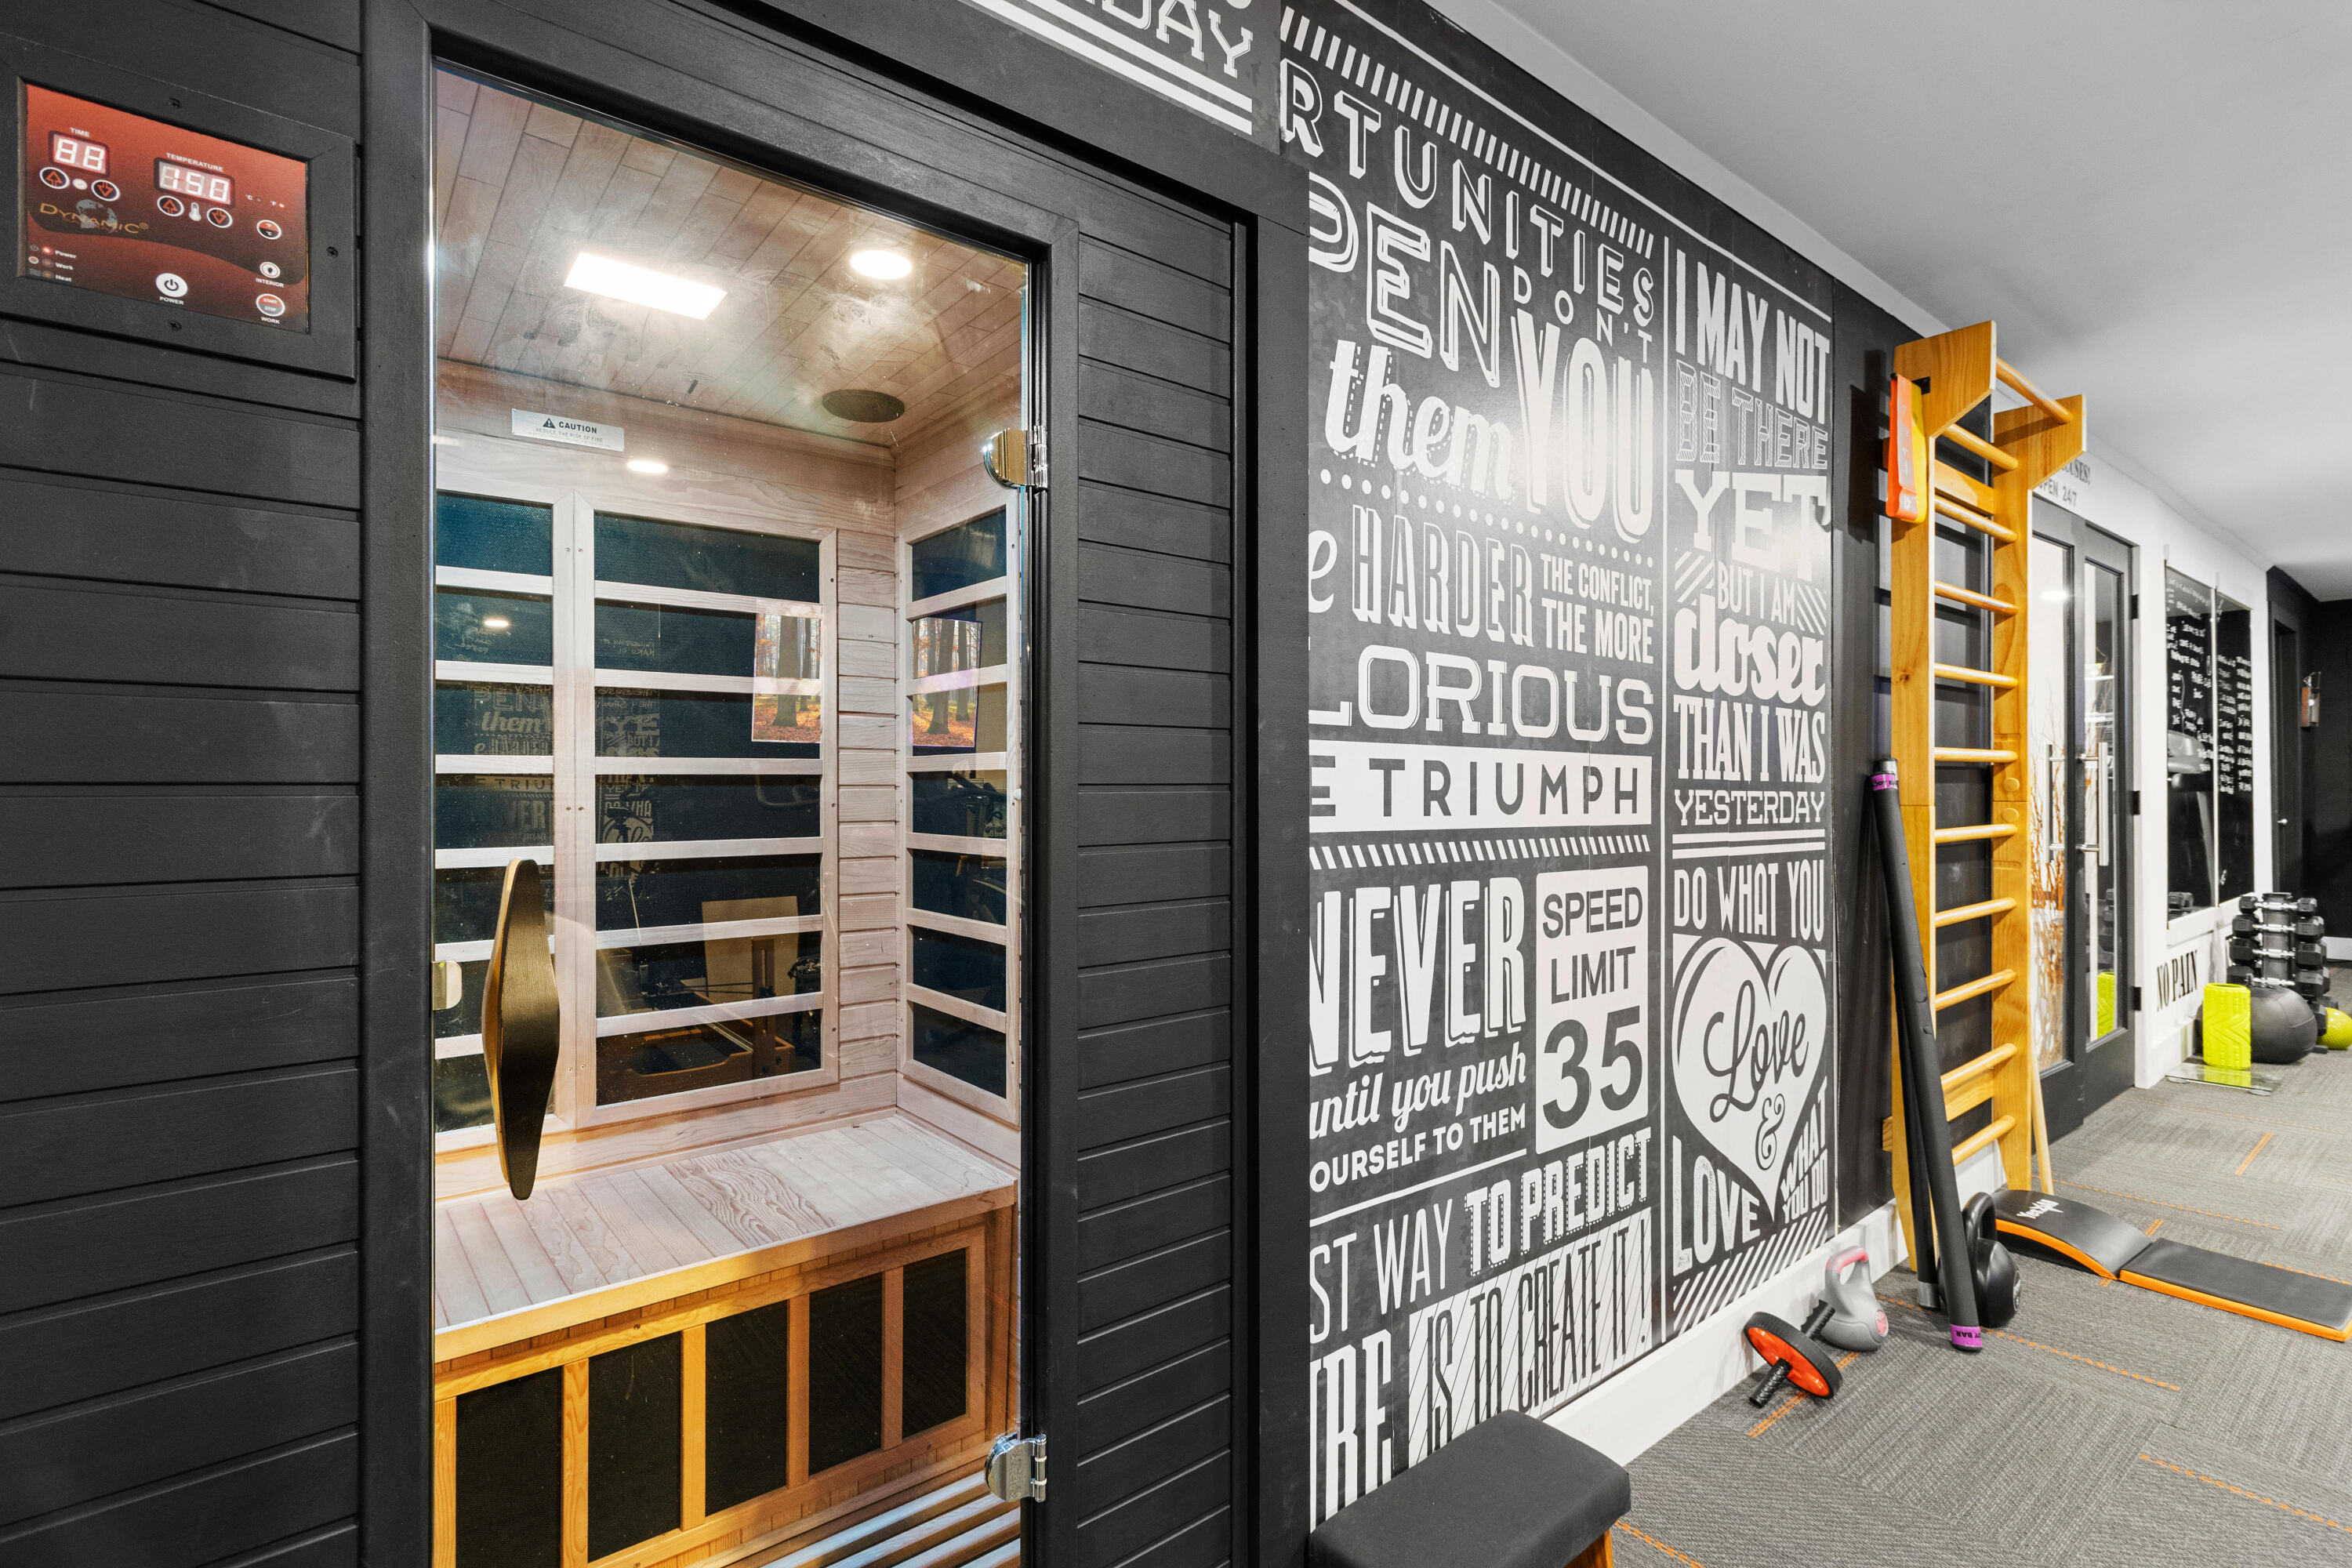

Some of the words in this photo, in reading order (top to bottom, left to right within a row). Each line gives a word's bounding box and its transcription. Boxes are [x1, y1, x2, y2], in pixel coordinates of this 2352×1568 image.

[54, 137, 106, 171] 88
[70, 127, 90, 138] TIME
[165, 151, 225, 172] TEMPERATURE
[1280, 58, 1653, 326] RTUNITIES
[55, 250, 77, 259] Power
[55, 262, 74, 270] Work
[256, 278, 285, 289] INTERIOR
[159, 295, 185, 306] POWER
[261, 316, 281, 325] WORK
[1675, 248, 1686, 356] I
[1697, 261, 1769, 393] MAY
[1776, 309, 1830, 425] NOT
[558, 421, 597, 434] CAUTION
[1324, 339, 1517, 506] them
[1510, 307, 1653, 544] YOU
[1676, 358, 1721, 464] BE
[1731, 386, 1828, 470] THERE
[2060, 459, 2091, 485] USES!
[1675, 469, 1831, 583] YET
[1352, 504, 1534, 648] HARDER
[1540, 553, 1574, 595] THE
[1577, 562, 1654, 616] CONFLICT,
[1717, 560, 1754, 616] BUT
[1759, 572, 1765, 620] I
[1770, 576, 1795, 626] AM
[1541, 597, 1588, 654] THE
[1595, 608, 1654, 665] MORE
[1674, 593, 1826, 707] closer
[1673, 694, 1754, 782] THAN
[1759, 705, 1770, 782] I
[1775, 706, 1826, 785] WAS
[1369, 757, 1639, 818] TRIUMPH
[1674, 788, 1825, 826] YESTERDAY
[1542, 887, 1643, 939] SPEED
[1674, 866, 1708, 930] DO
[1717, 862, 1779, 936] WHAT
[1787, 858, 1825, 942] YOU
[1309, 875, 1526, 1077] NEVER
[1550, 946, 1636, 1004] LIMIT
[2157, 963, 2169, 1012] NO
[2172, 949, 2198, 1003] PAIN
[1542, 1005, 1643, 1130] 35
[1703, 979, 1809, 1123] Love
[1309, 1072, 1384, 1140] until
[1391, 1069, 1451, 1134] you
[1455, 1041, 1526, 1116] push
[1309, 1131, 1427, 1193] OURSELF
[1432, 1122, 1464, 1155] TO
[1469, 1102, 1526, 1144] THEM
[1780, 1076, 1828, 1203] WHAT
[1374, 1198, 1453, 1316] WAY
[1464, 1178, 1512, 1276] TO
[1521, 1127, 1652, 1257] PREDICT
[1672, 1134, 1761, 1277] LOVE
[1782, 1174, 1809, 1225] YOU
[1811, 1148, 1828, 1209] DO
[1470, 1286, 1503, 1425] TO
[1518, 1239, 1601, 1413] CREATE
